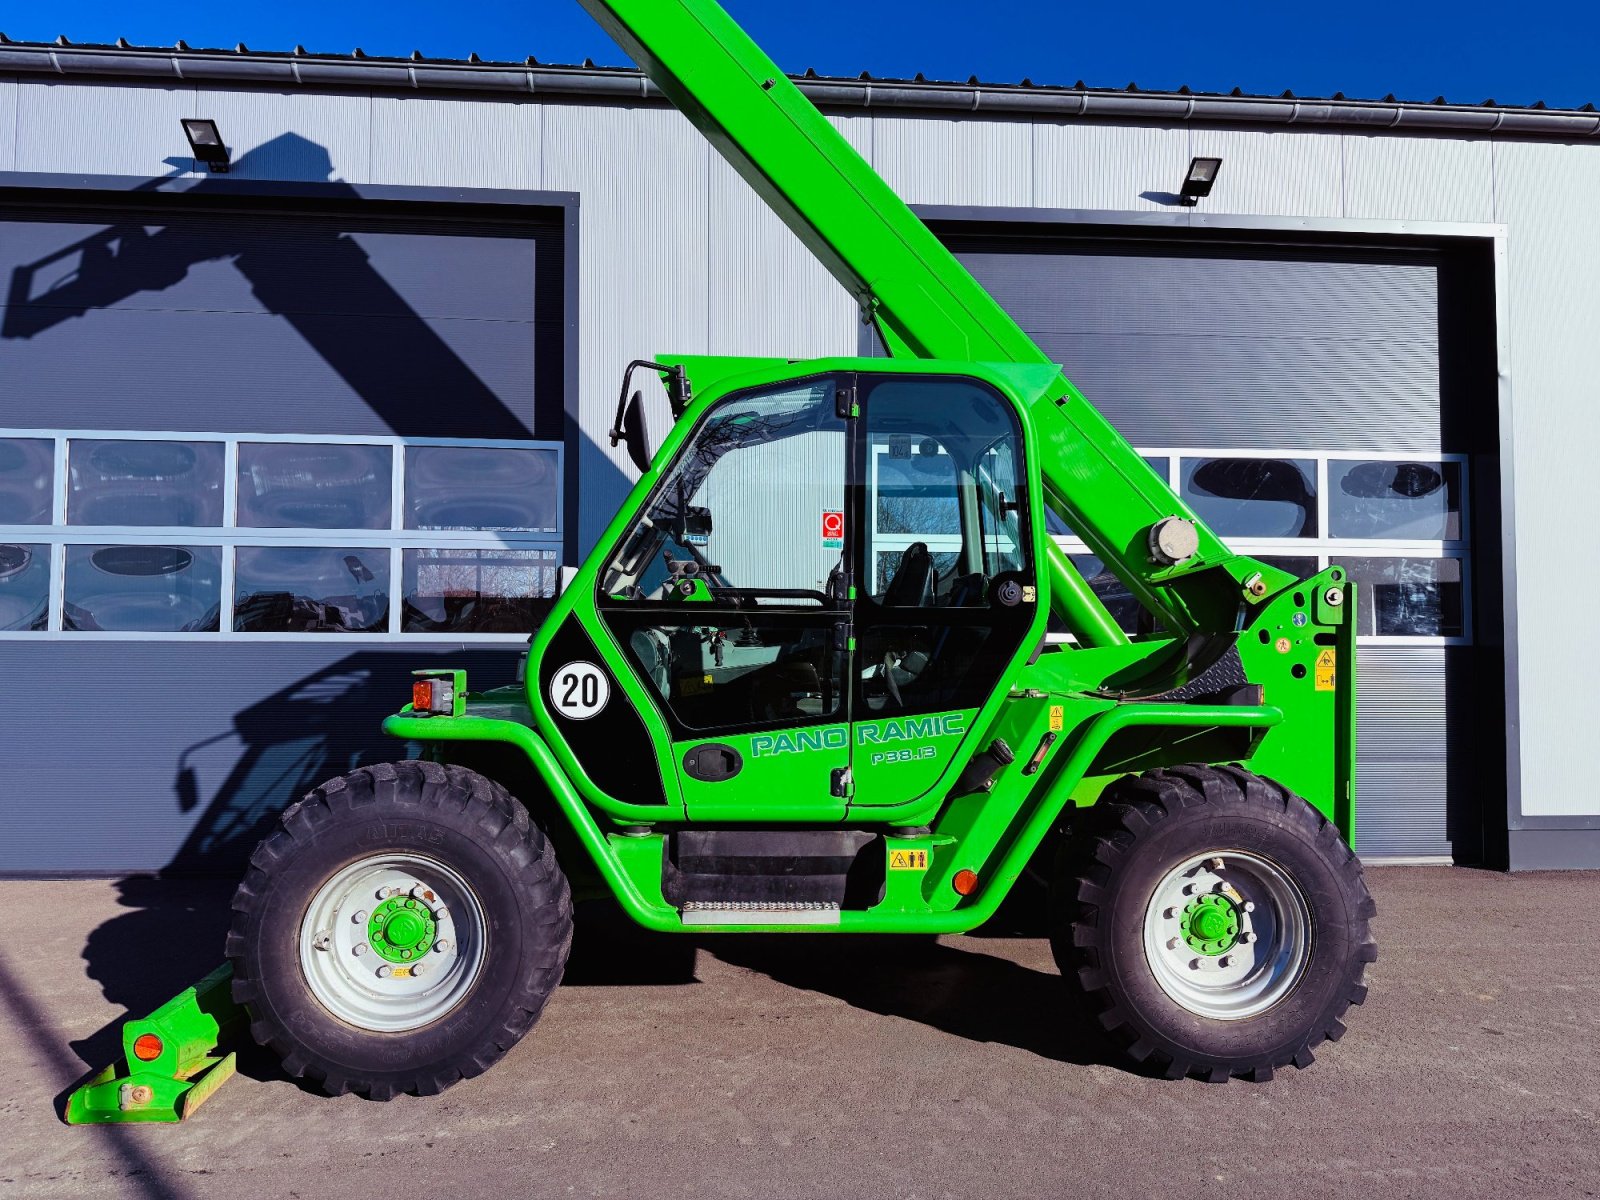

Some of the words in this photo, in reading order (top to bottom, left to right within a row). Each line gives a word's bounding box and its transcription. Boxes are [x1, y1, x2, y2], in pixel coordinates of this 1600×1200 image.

[562, 673, 598, 707] 20
[751, 728, 848, 757] PANO
[857, 714, 964, 745] RAMIC
[871, 746, 936, 765] P38.13
